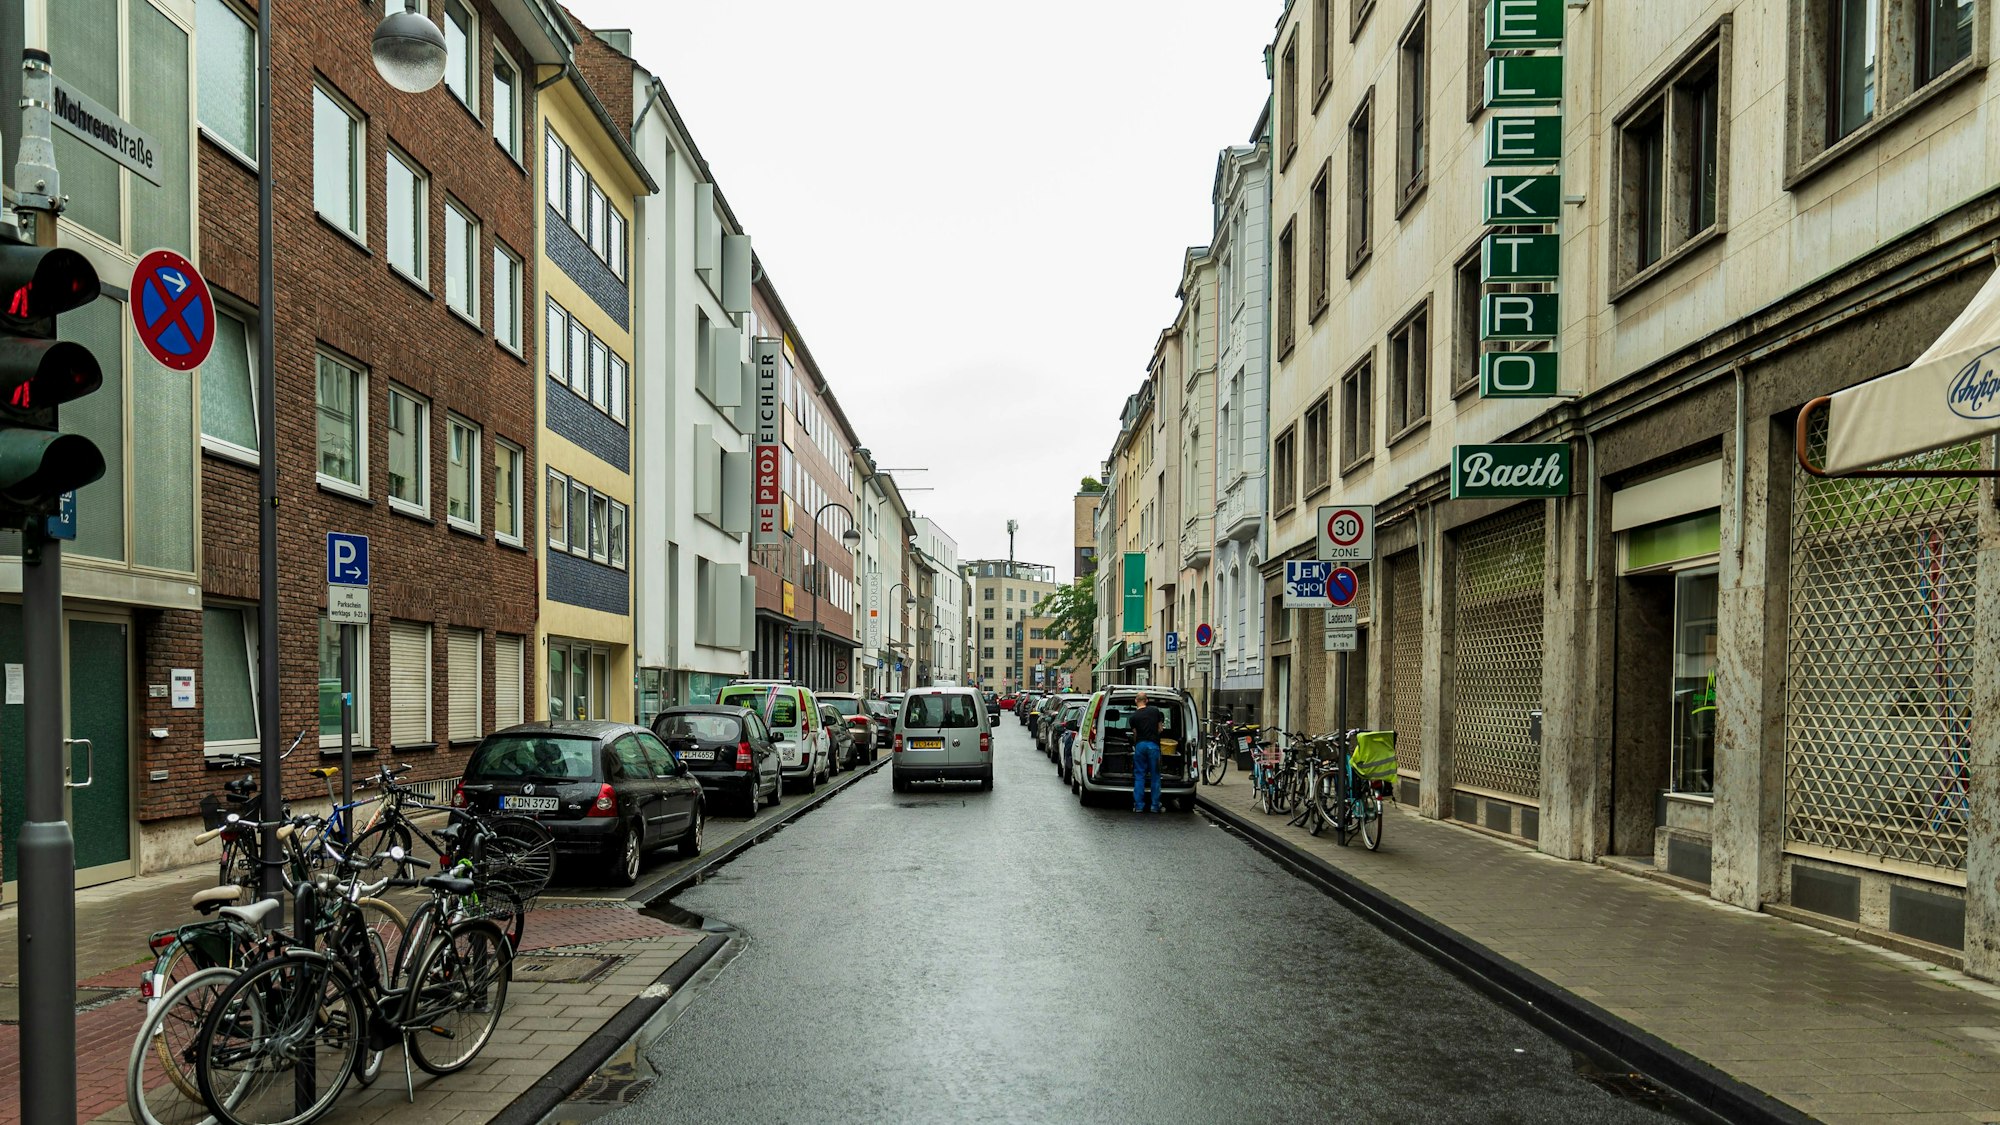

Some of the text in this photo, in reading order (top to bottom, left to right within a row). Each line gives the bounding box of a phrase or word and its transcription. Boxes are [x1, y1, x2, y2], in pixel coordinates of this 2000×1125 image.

[54, 86, 153, 169] Mohrenstraße
[1493, 0, 1537, 391] ELEKTRO
[761, 354, 774, 443] EICHLER
[1462, 452, 1564, 487] Baeth
[1335, 519, 1356, 536] 30
[334, 539, 357, 578] P
[1331, 548, 1360, 558] ZONE
[337, 600, 361, 608] Parkschein
[331, 610, 351, 618] werktags
[1327, 612, 1353, 624] Ladezone
[1167, 634, 1175, 650] P
[505, 797, 512, 807] K
[518, 797, 531, 808] DN
[532, 798, 557, 809] 3737
